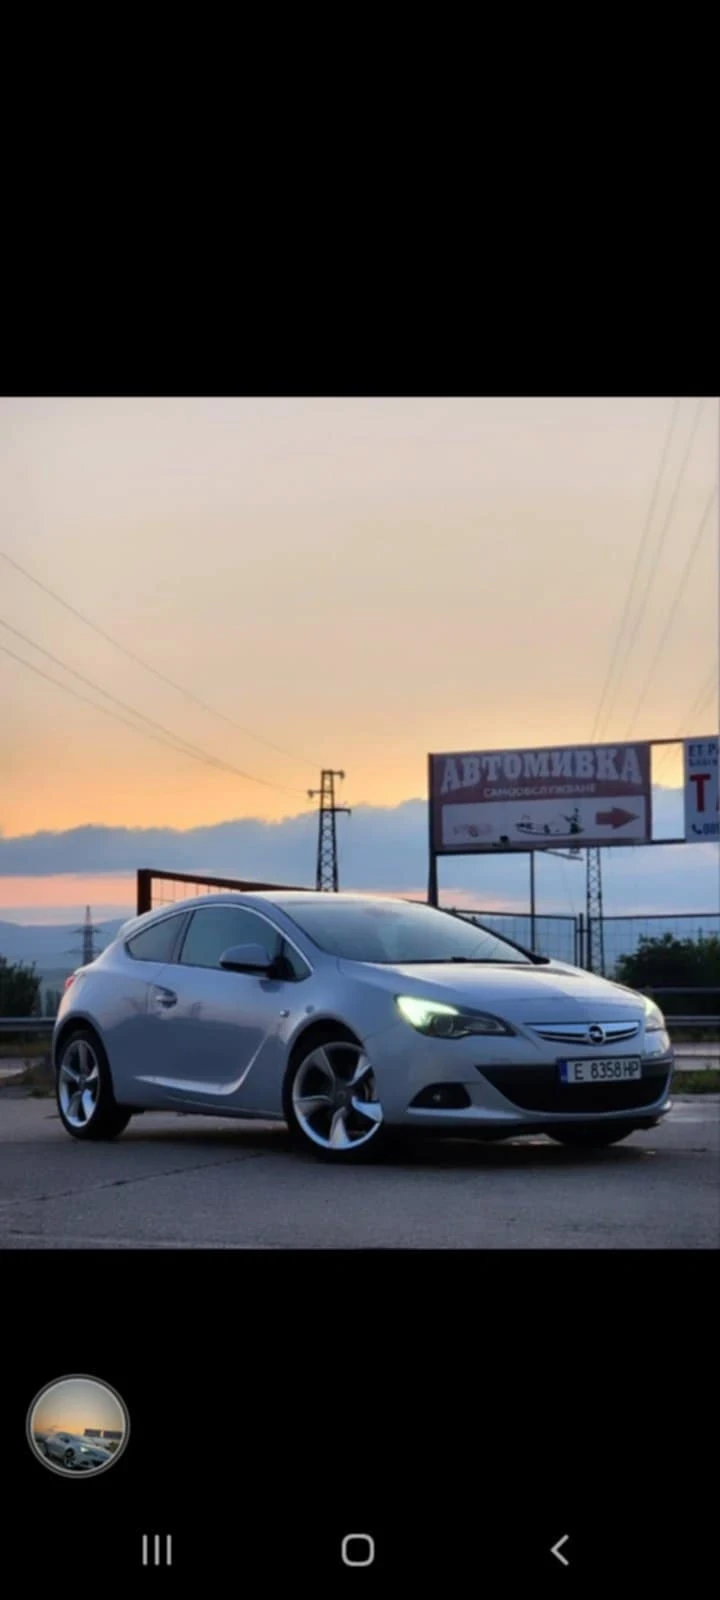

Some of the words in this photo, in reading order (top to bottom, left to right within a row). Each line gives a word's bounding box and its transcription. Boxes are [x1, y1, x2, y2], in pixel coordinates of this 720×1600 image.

[440, 748, 643, 795] АВТОМИВКА
[574, 1063, 584, 1080] E
[591, 1061, 621, 1079] 8358
